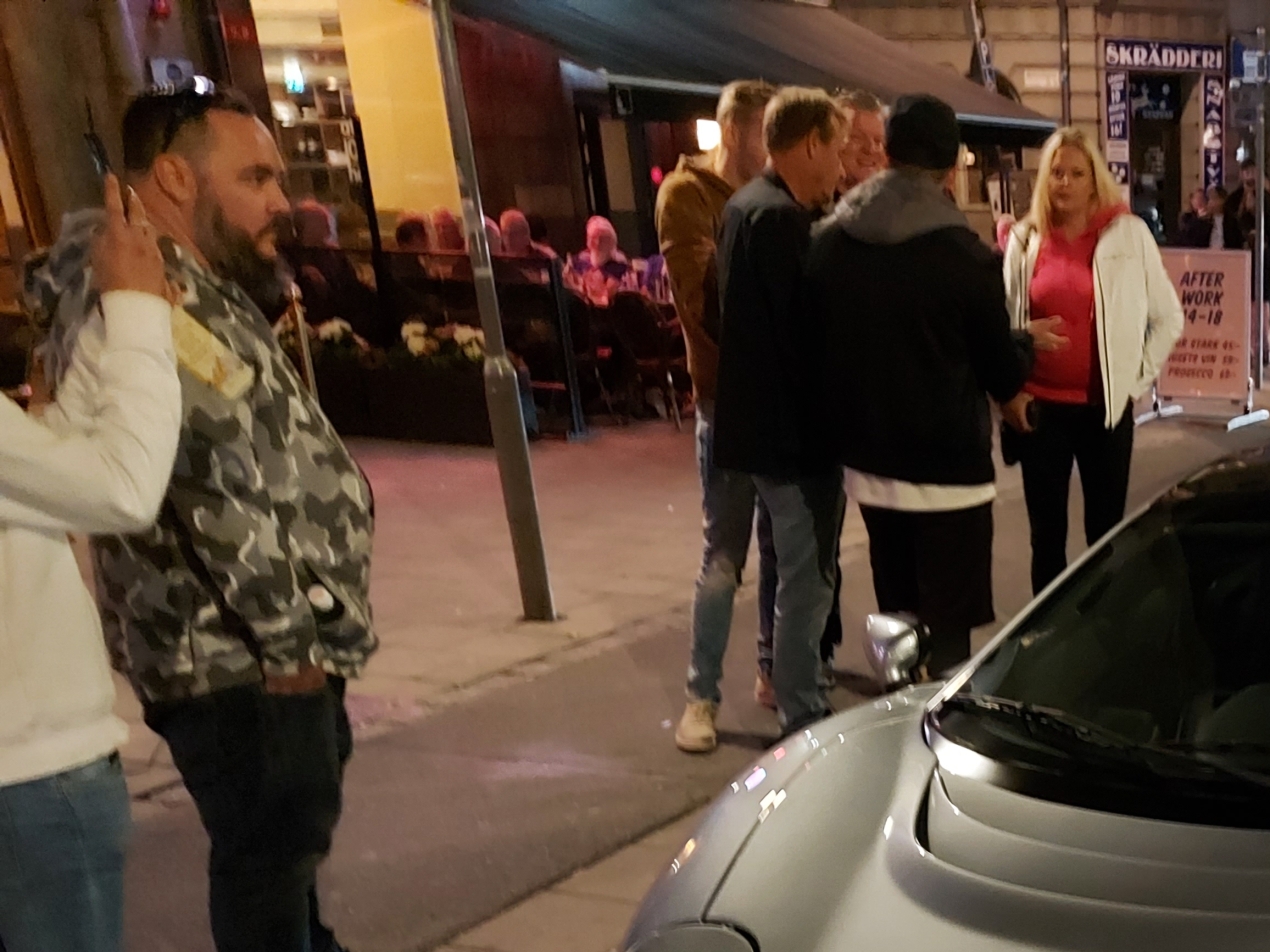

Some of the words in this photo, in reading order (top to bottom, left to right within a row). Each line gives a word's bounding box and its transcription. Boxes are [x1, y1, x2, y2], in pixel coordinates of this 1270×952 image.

[1106, 42, 1223, 69] SKRÄDDERI
[1180, 271, 1225, 287] AFTER
[1181, 290, 1224, 306] WORK
